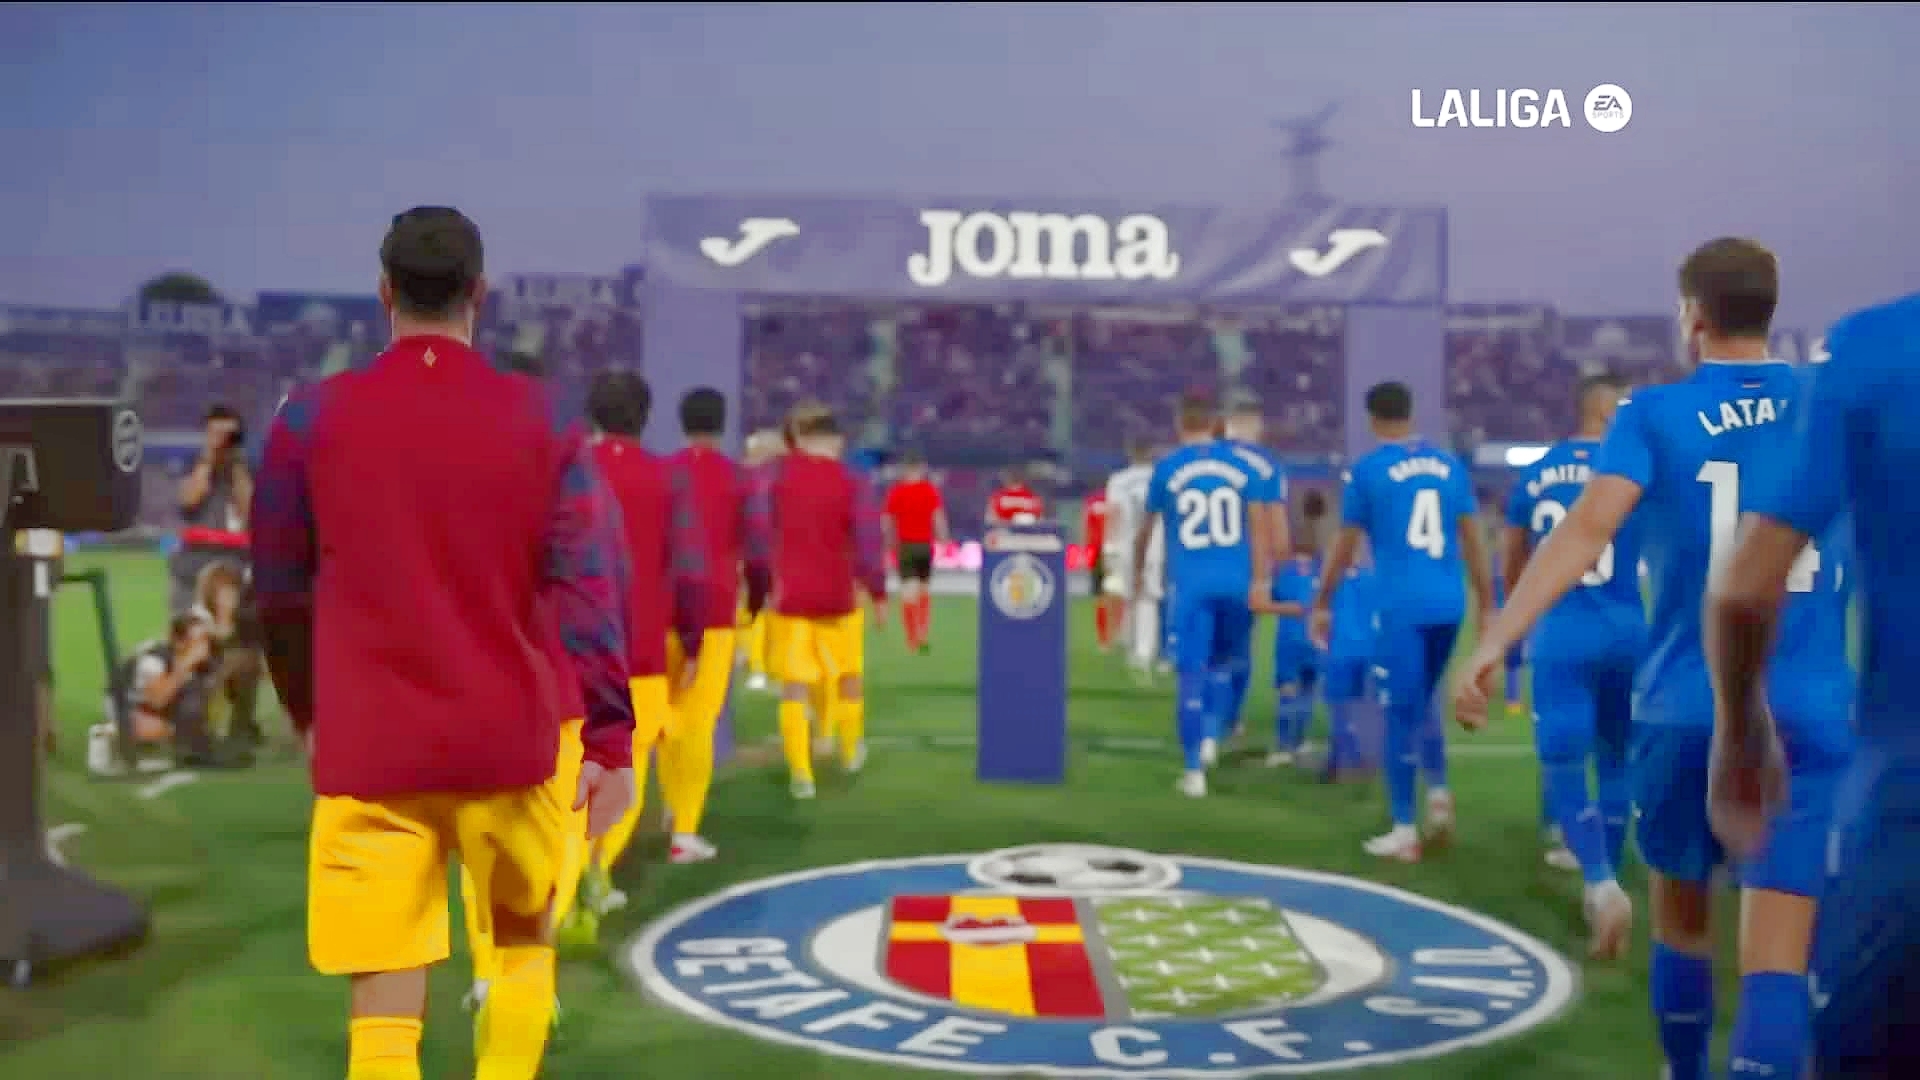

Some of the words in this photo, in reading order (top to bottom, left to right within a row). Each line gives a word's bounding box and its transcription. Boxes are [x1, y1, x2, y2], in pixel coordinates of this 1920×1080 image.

[1697, 397, 1788, 437] LATA
[1178, 486, 1241, 549] 20
[1407, 488, 1446, 559] 4
[674, 938, 1007, 1056] GETAFE
